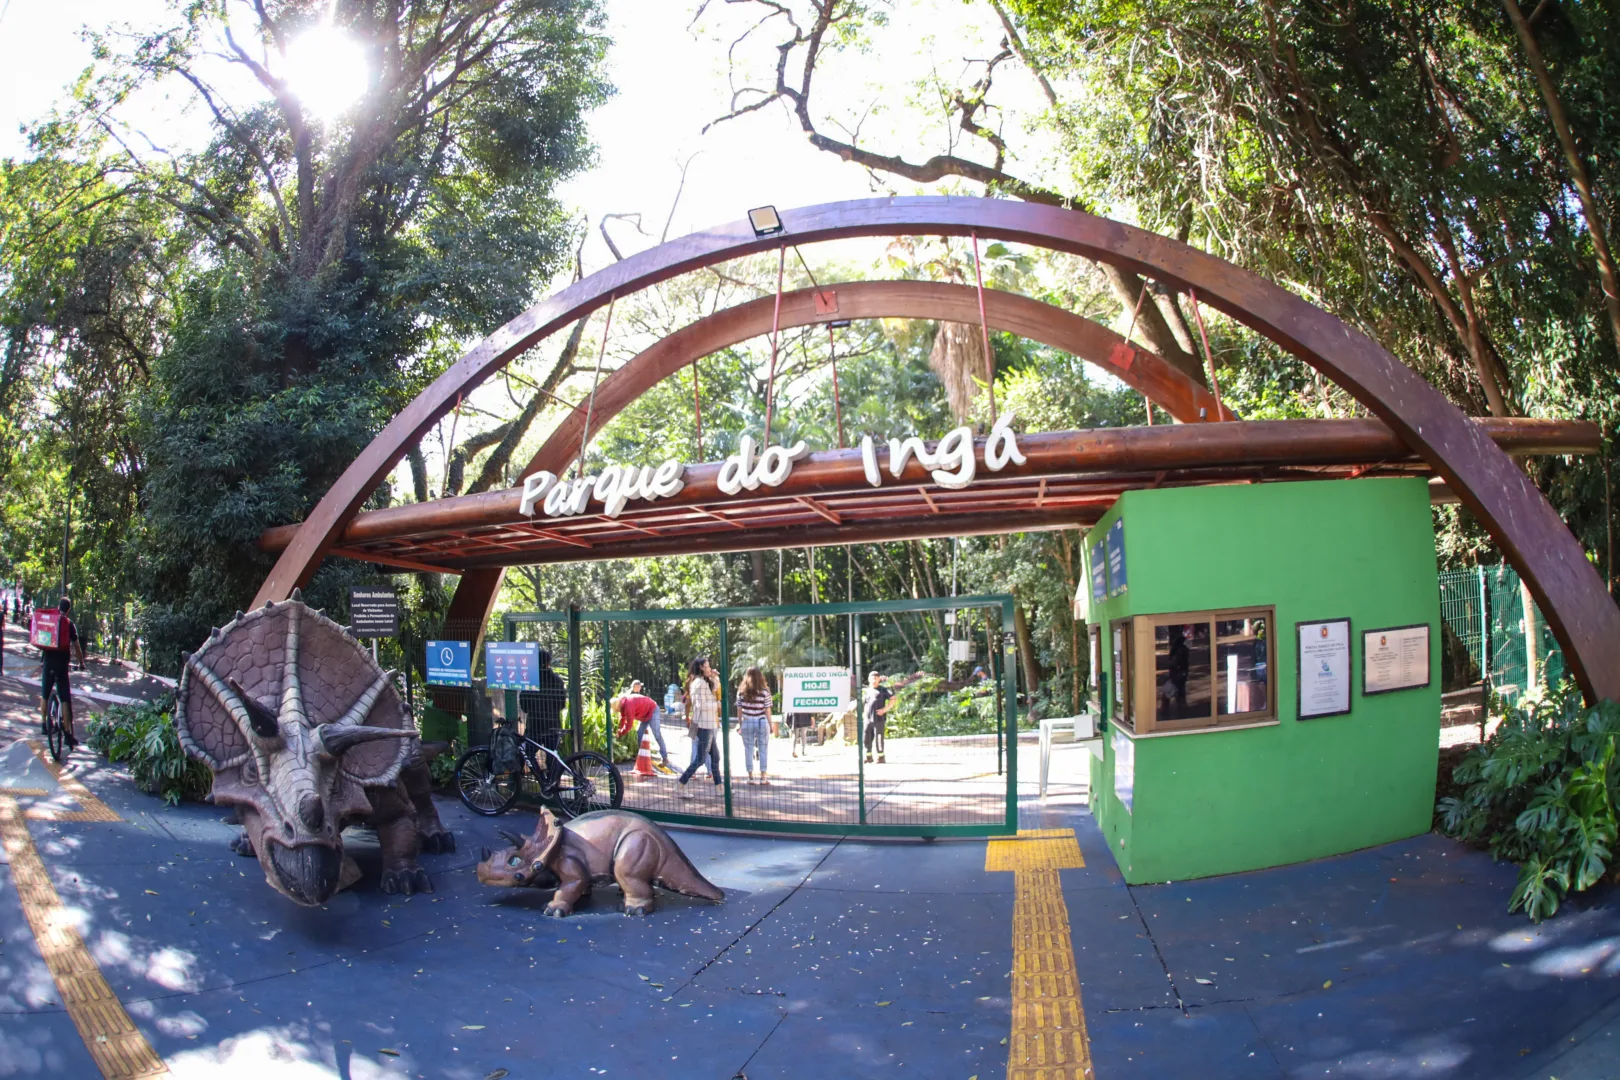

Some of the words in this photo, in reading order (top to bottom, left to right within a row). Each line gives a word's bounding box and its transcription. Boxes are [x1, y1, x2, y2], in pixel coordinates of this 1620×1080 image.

[519, 459, 685, 519] Parque
[717, 434, 809, 495] do
[861, 411, 1027, 489] Ingá
[804, 682, 828, 690] HOJE
[795, 698, 836, 706] FECHADO
